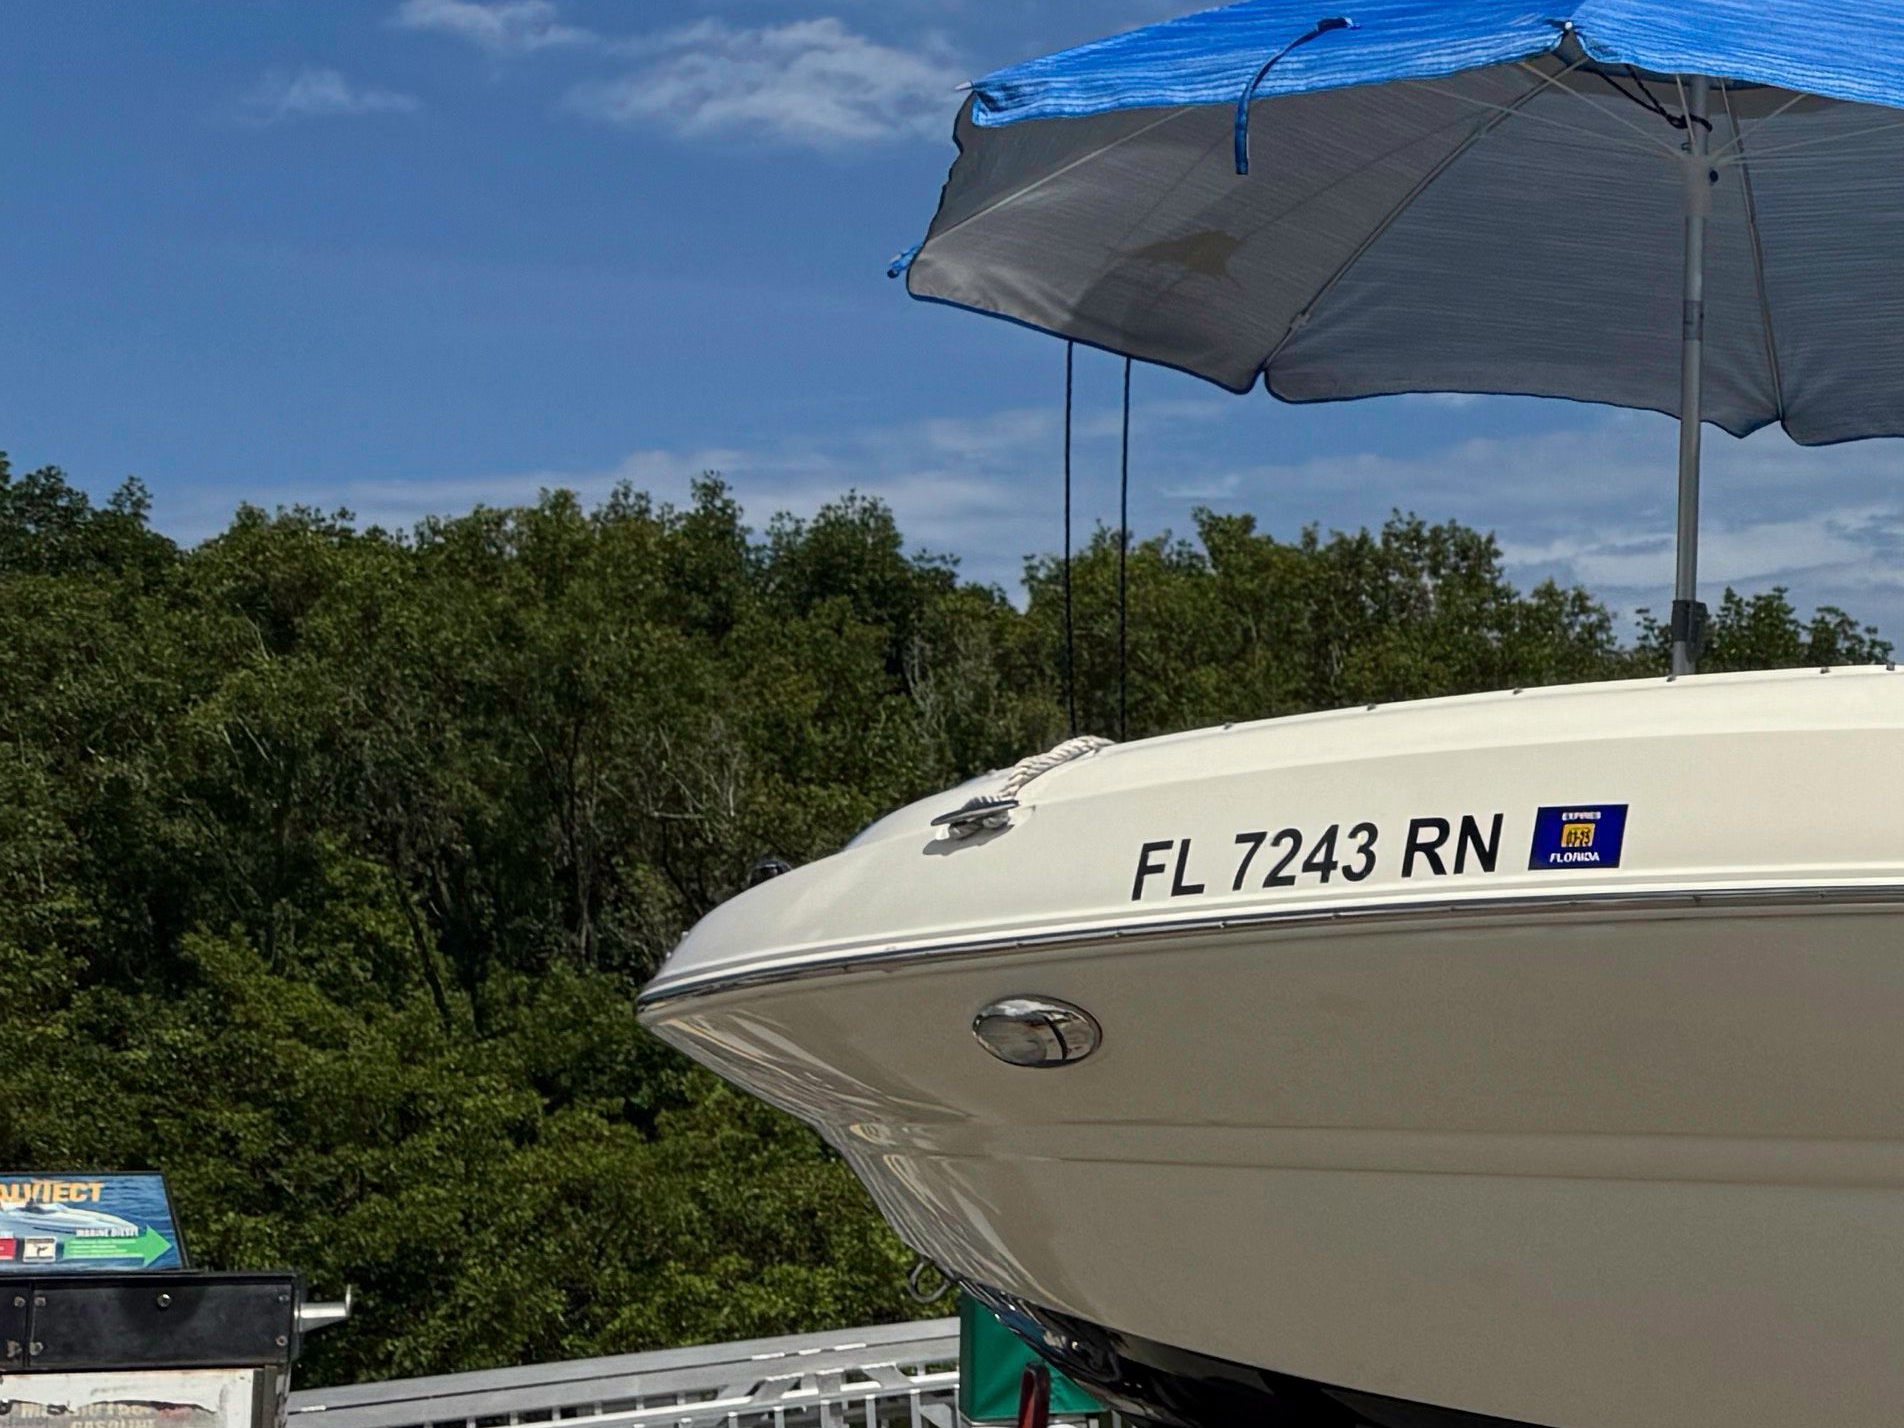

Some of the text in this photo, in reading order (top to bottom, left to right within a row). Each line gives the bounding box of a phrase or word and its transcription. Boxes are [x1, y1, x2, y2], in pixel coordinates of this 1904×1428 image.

[1131, 812, 1504, 901] FL 7243 RN
[1550, 851, 1600, 863] FLORIDA
